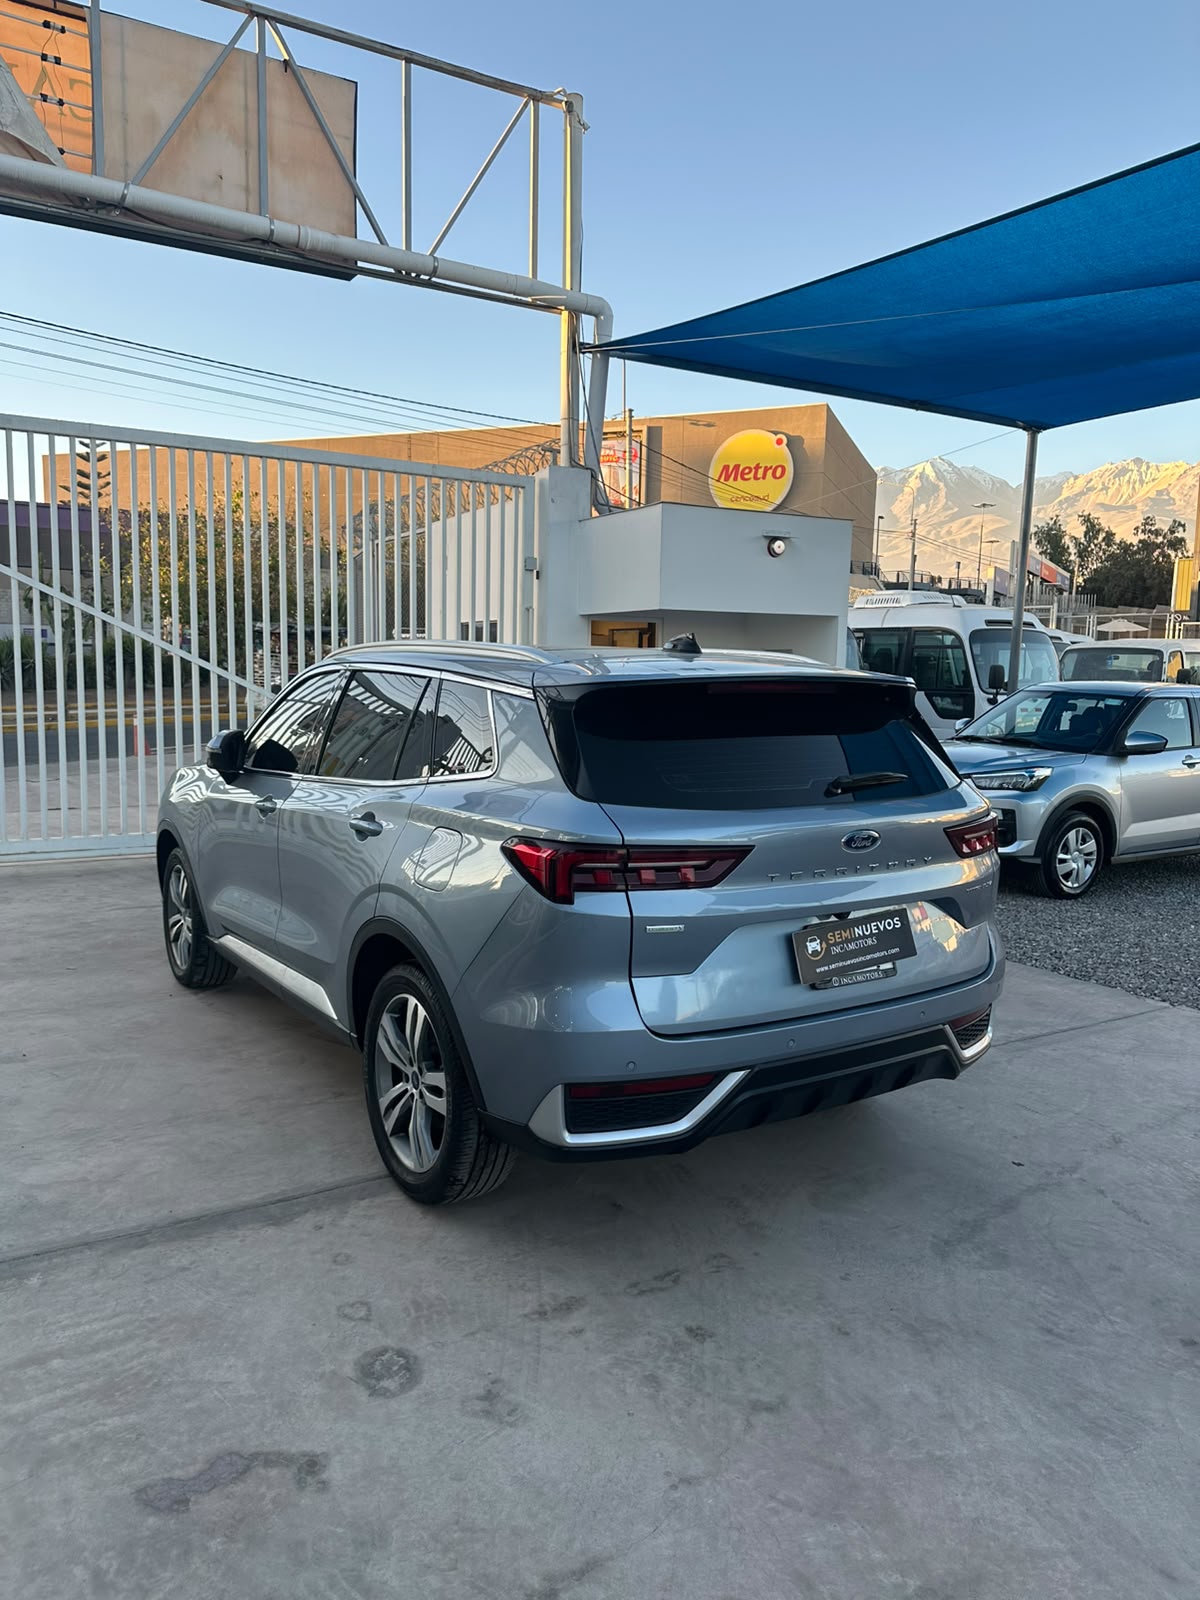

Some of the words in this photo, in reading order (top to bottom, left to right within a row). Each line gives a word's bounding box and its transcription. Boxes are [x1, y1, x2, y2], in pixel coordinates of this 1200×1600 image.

[717, 463, 787, 482] Metro
[851, 835, 874, 848] Ford
[827, 917, 902, 944] SEMINUEVOS
[830, 937, 877, 955] INCAMOTORS
[815, 947, 900, 973] www.seminuevosincamotors.com
[840, 970, 883, 985] INCAMOTORS
